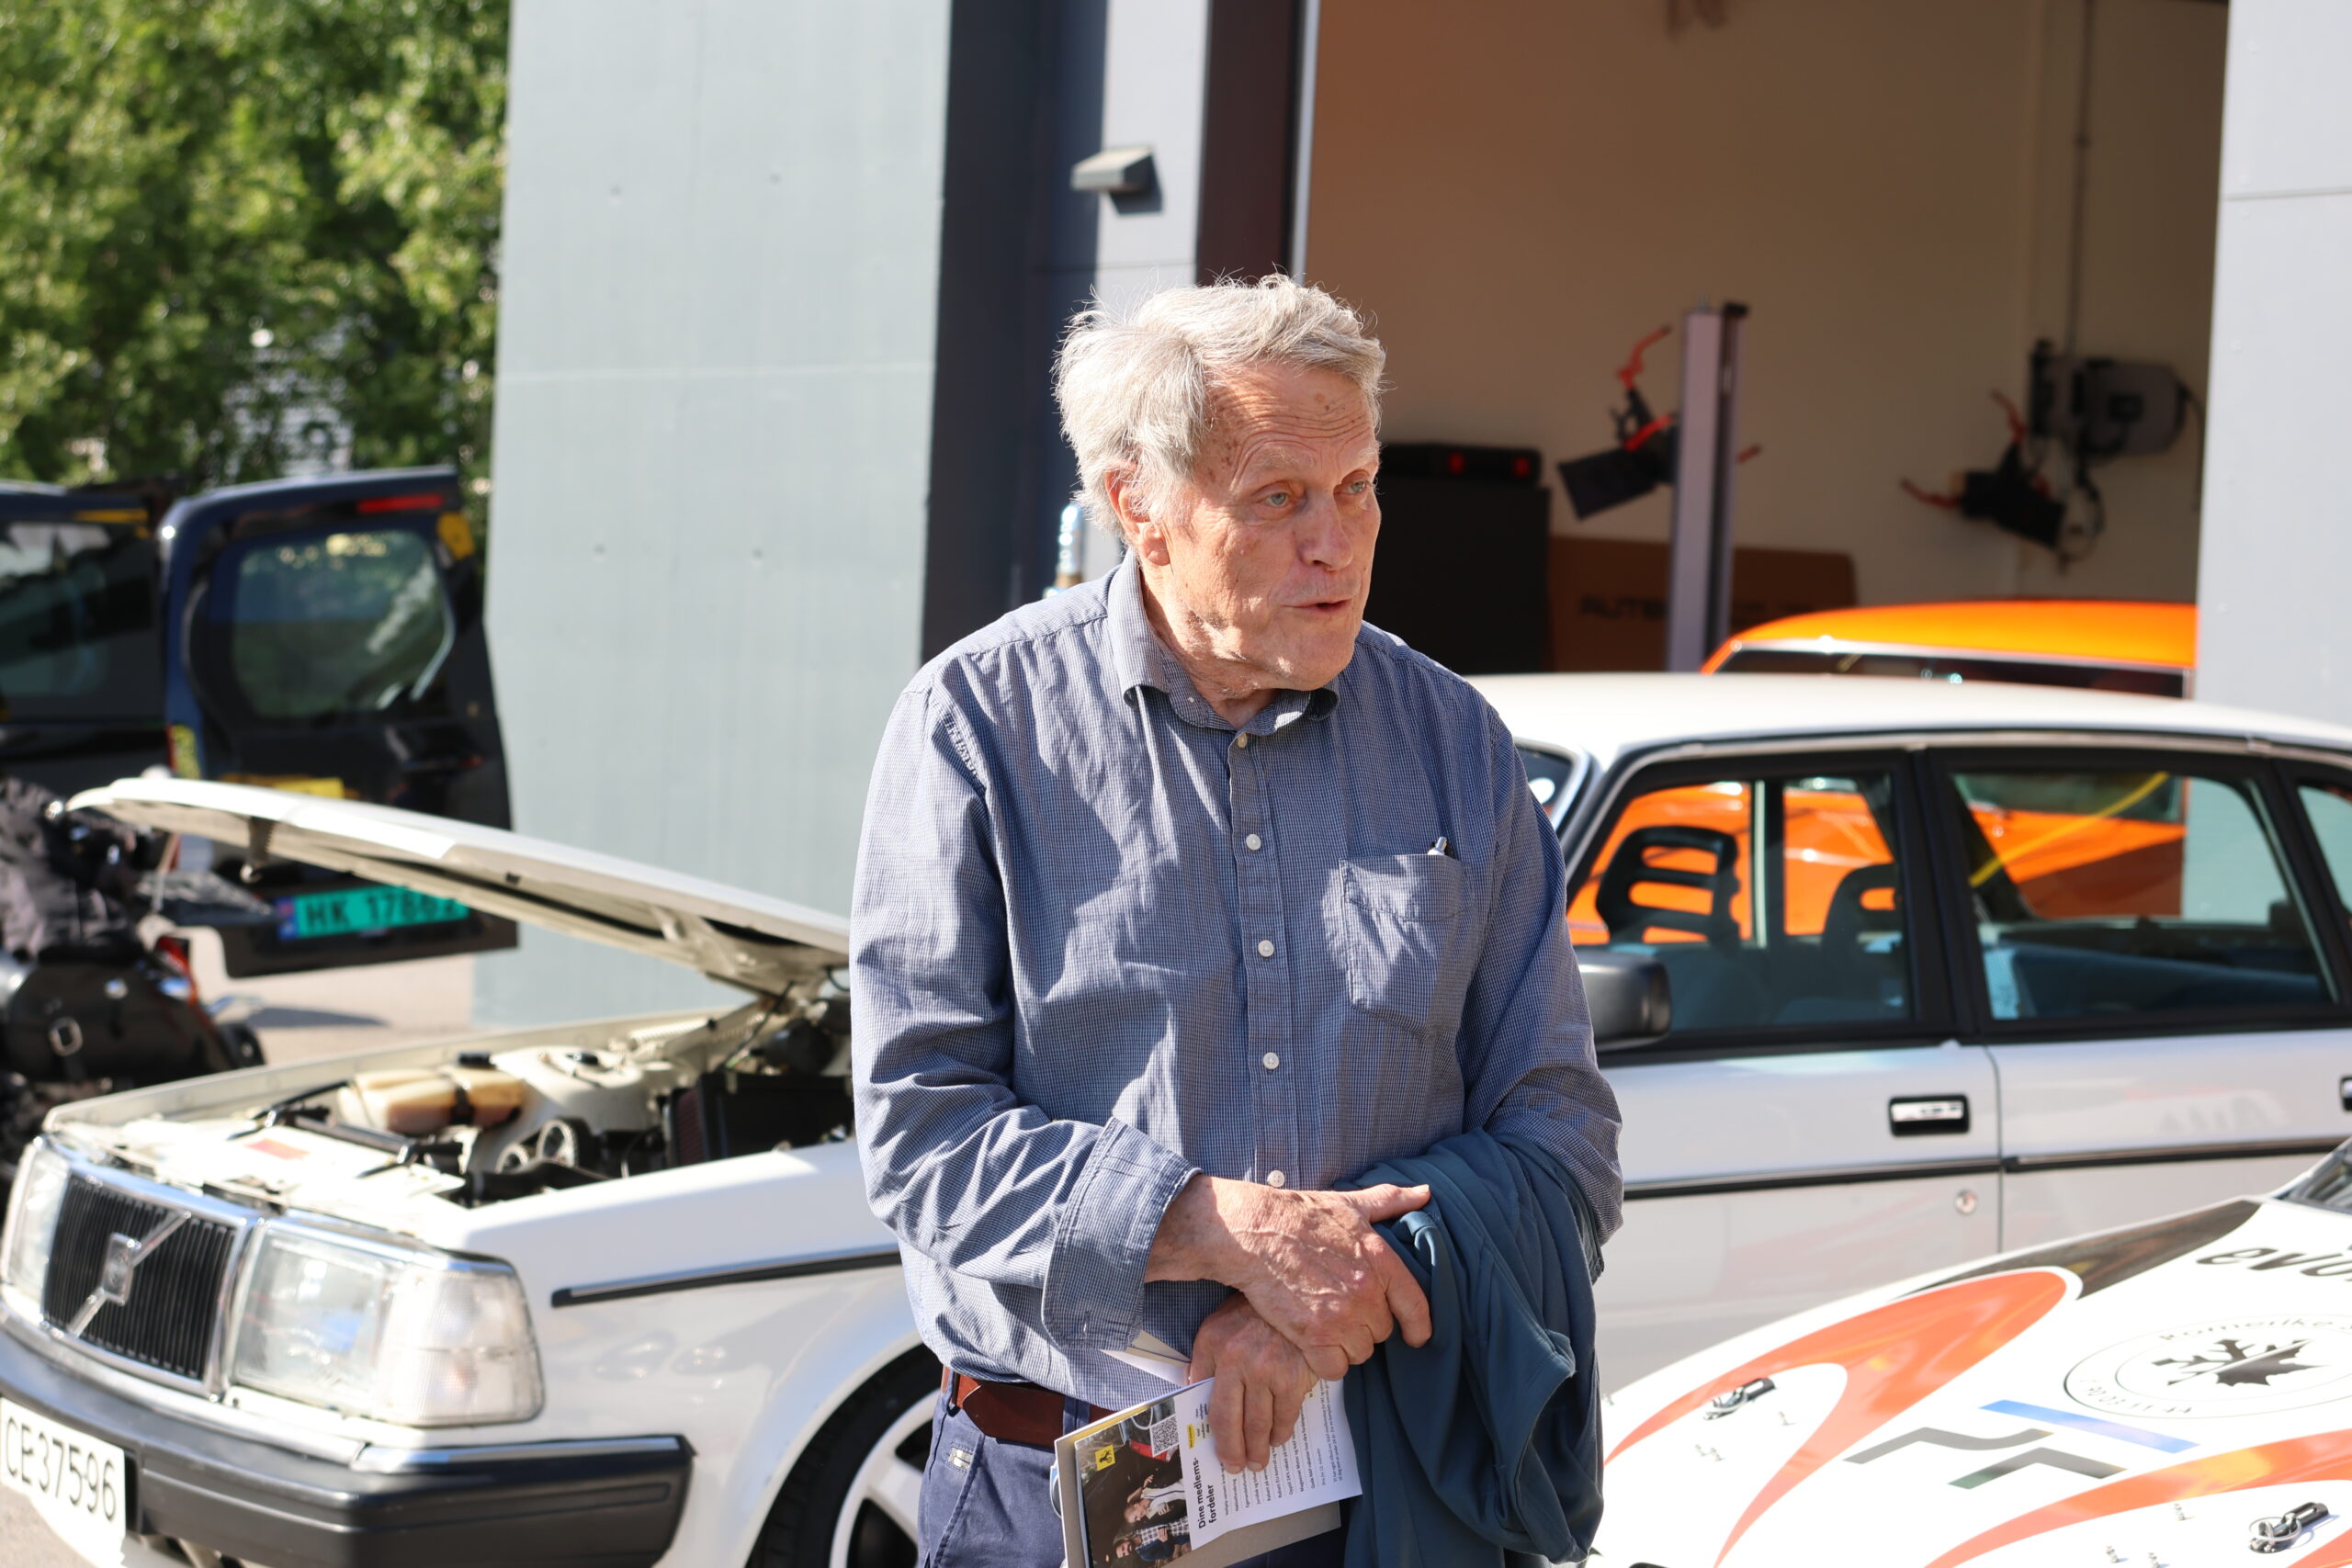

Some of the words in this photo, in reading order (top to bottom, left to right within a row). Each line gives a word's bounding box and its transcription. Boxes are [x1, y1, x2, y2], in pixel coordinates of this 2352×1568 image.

[305, 897, 351, 928] HK
[1193, 1457, 1203, 1505] medlems-
[1198, 1506, 1206, 1529] Dine
[1206, 1484, 1216, 1523] fordeler
